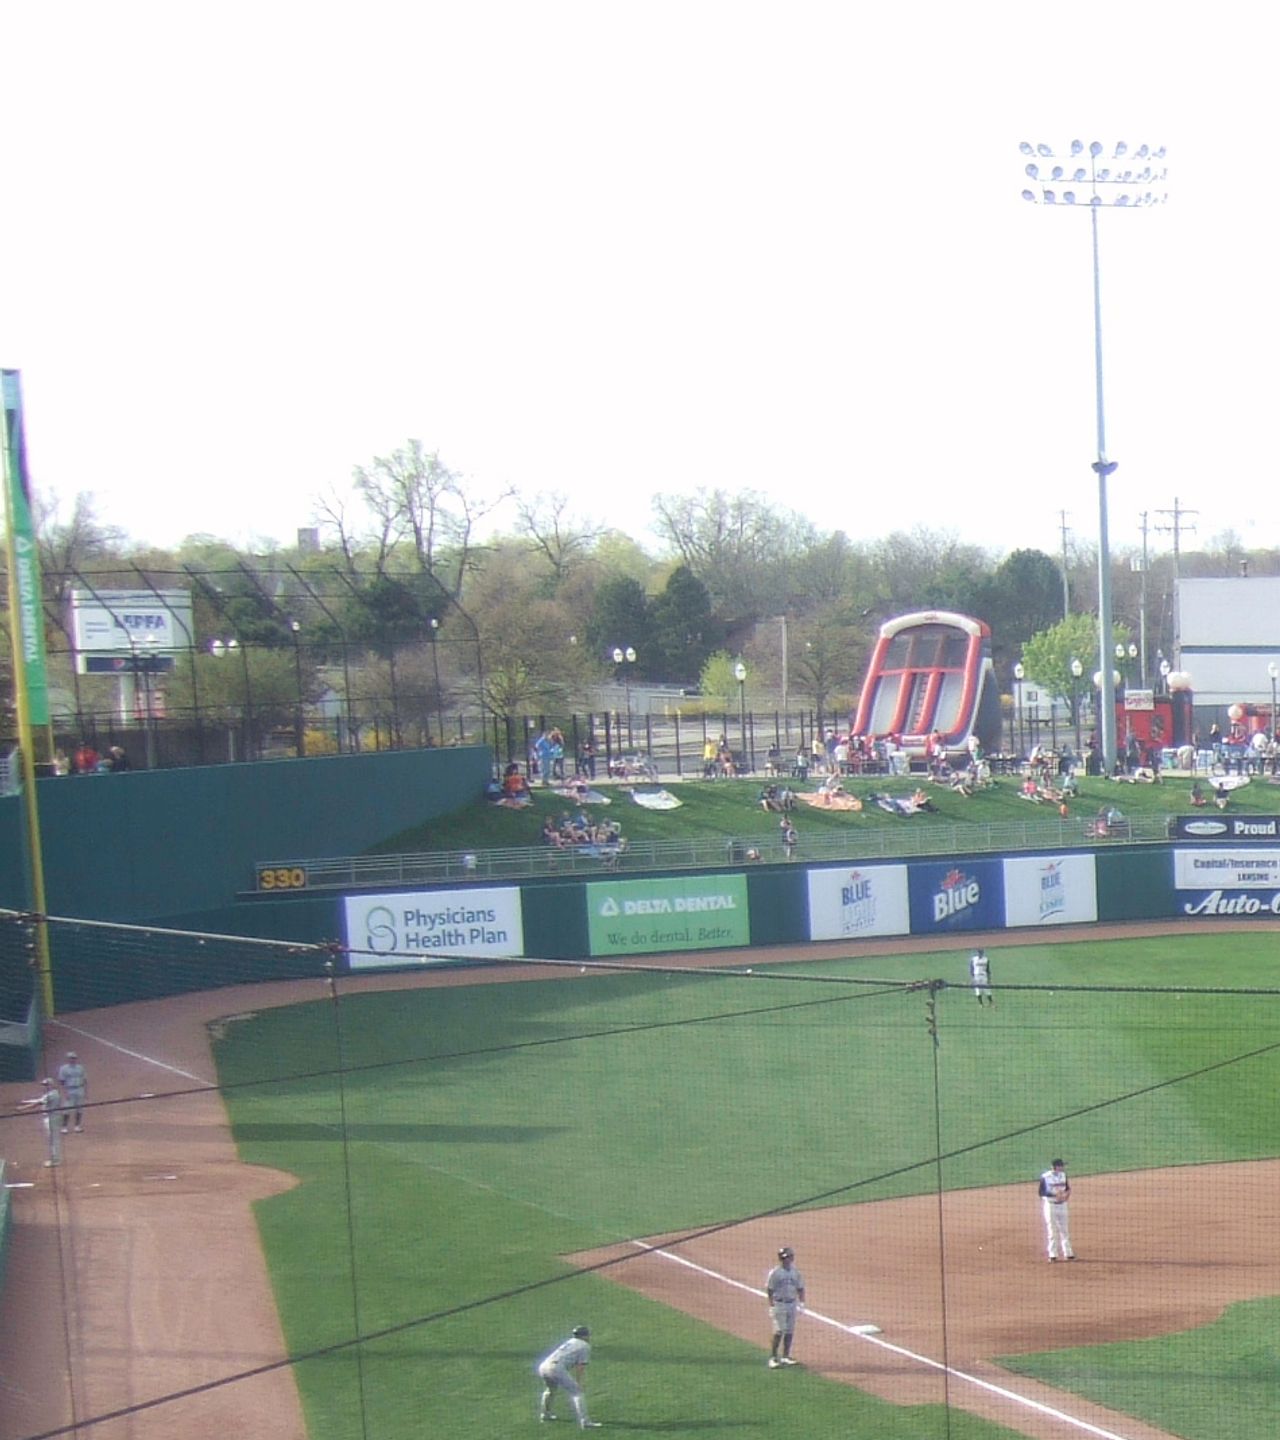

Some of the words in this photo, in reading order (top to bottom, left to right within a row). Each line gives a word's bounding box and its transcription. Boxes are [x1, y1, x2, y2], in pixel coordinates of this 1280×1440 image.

[1234, 821, 1276, 835] Proud
[261, 869, 304, 888] 330
[1041, 872, 1061, 890] BLUE
[842, 880, 872, 906] BLUE
[933, 881, 980, 922] Blue
[624, 900, 673, 915] DELTA
[674, 896, 736, 912] DENTAL
[403, 907, 495, 931] Physicians
[405, 929, 465, 949] Health
[469, 928, 508, 944] Plan
[607, 934, 628, 945] We
[631, 930, 647, 945] do
[650, 928, 692, 944] dental.
[698, 928, 734, 940] Better.
